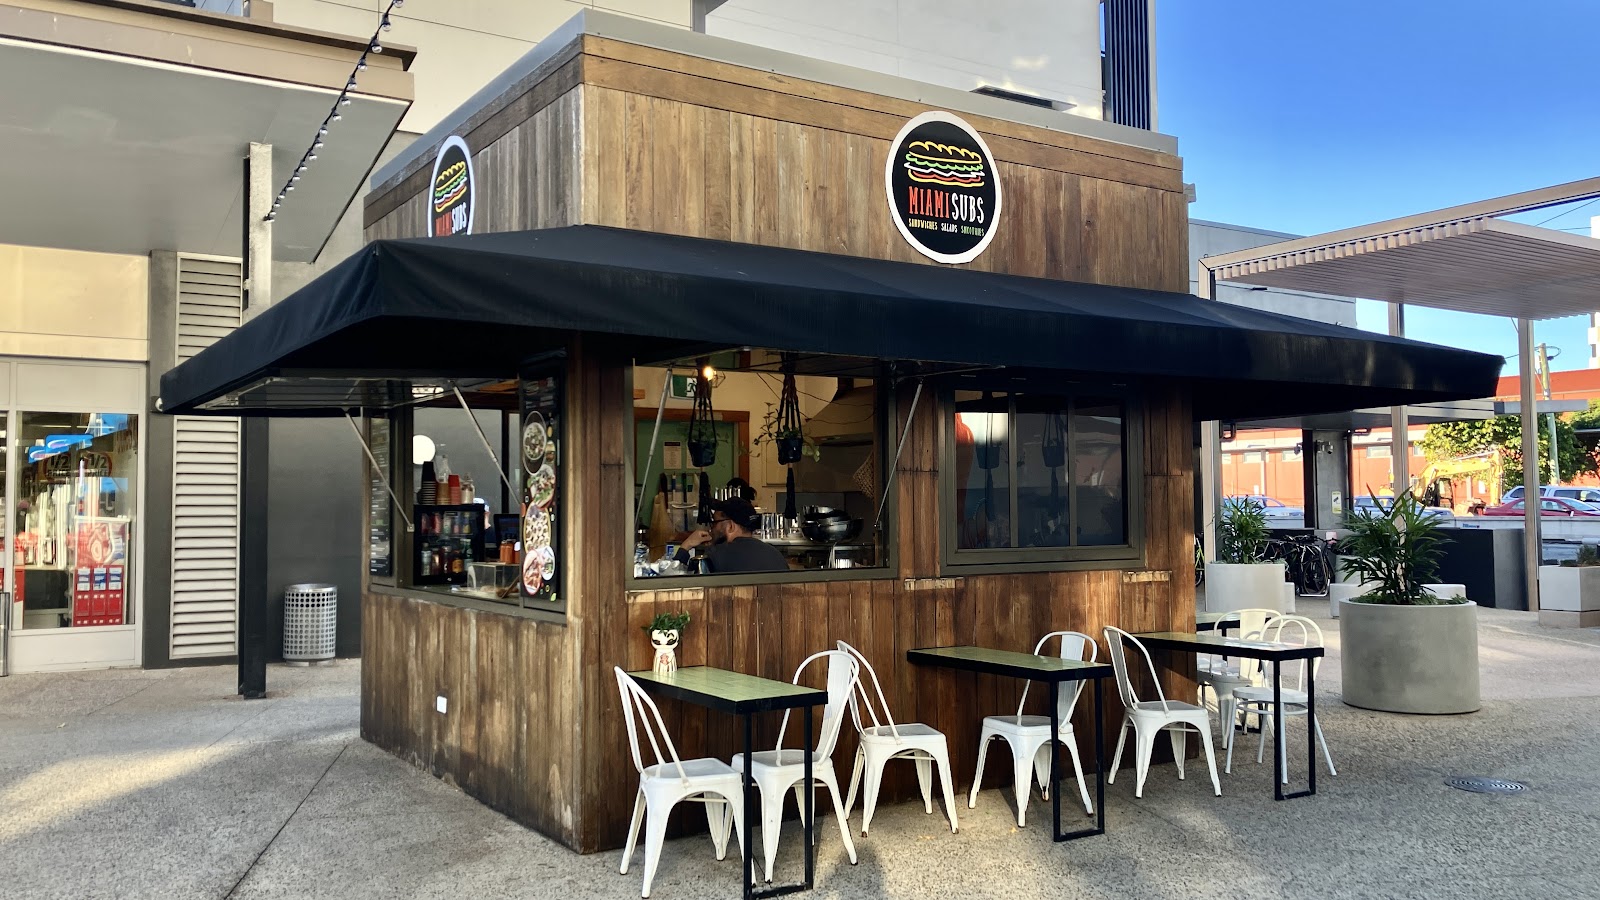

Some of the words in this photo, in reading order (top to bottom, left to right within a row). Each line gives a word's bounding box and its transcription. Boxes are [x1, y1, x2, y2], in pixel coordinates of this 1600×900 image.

[909, 186, 950, 219] MIAMI
[951, 192, 985, 224] SUBS
[908, 218, 938, 231] SANDWICHES
[941, 222, 958, 234] SALADS
[50, 453, 69, 469] 1/2
[90, 453, 108, 469] 1/2
